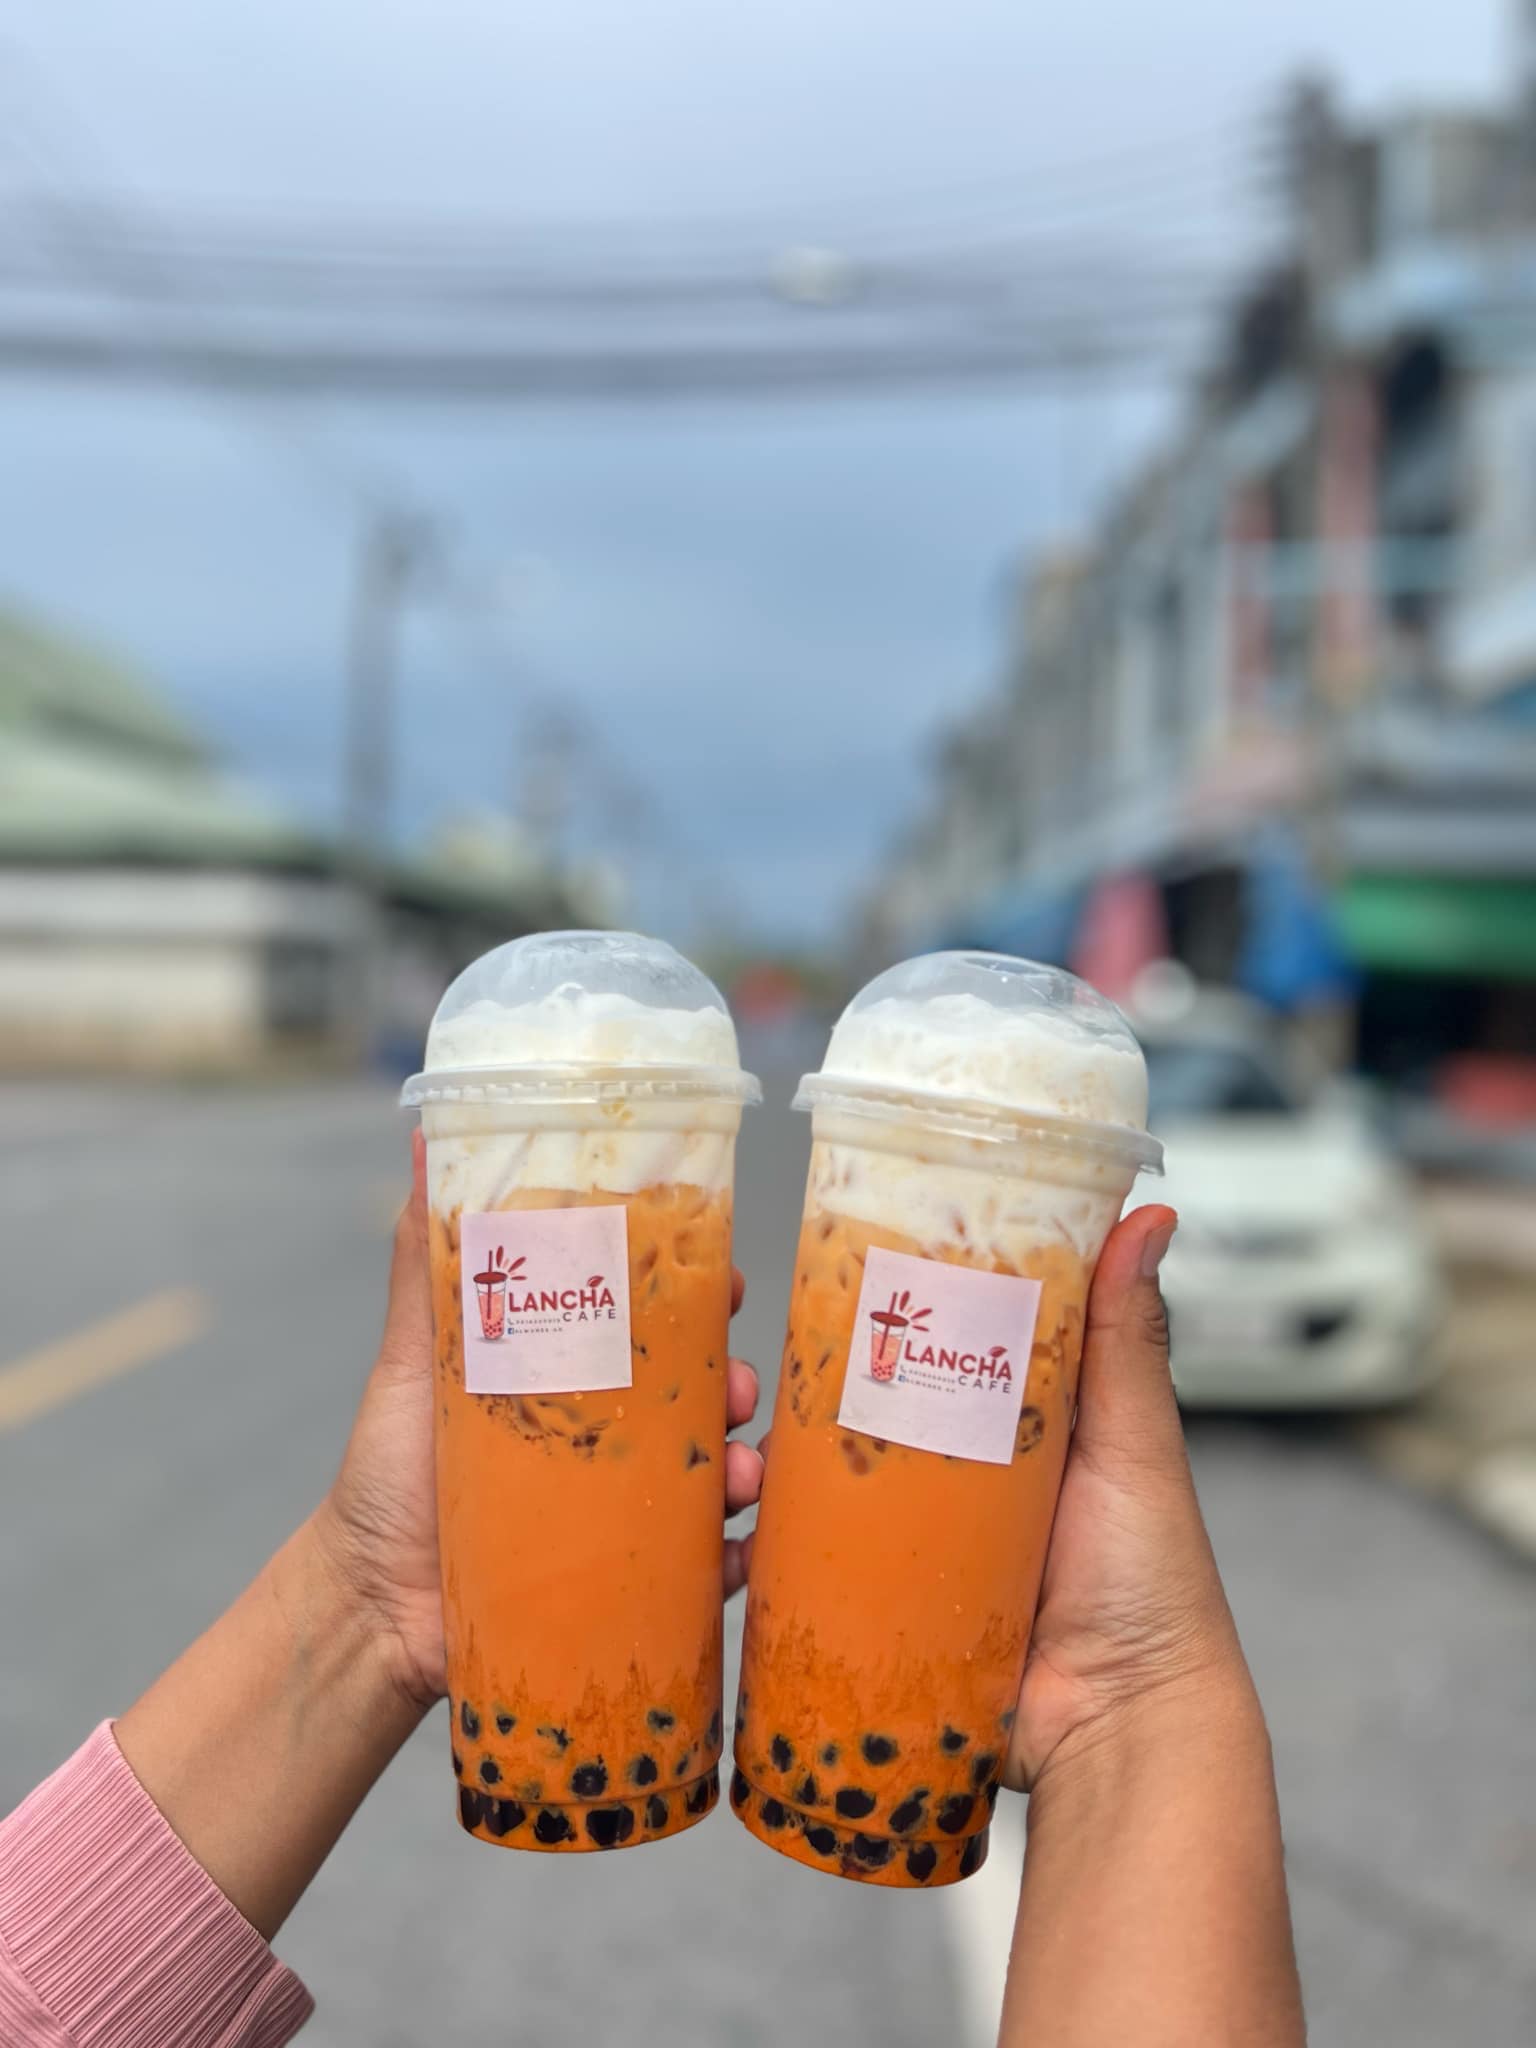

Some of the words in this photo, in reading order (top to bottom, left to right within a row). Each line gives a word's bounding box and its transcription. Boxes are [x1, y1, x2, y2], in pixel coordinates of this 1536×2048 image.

[508, 1288, 615, 1312] LANCHA
[562, 1309, 616, 1322] CAFE
[904, 1340, 1012, 1381] LANCHA
[958, 1375, 1012, 1394] CAFE
